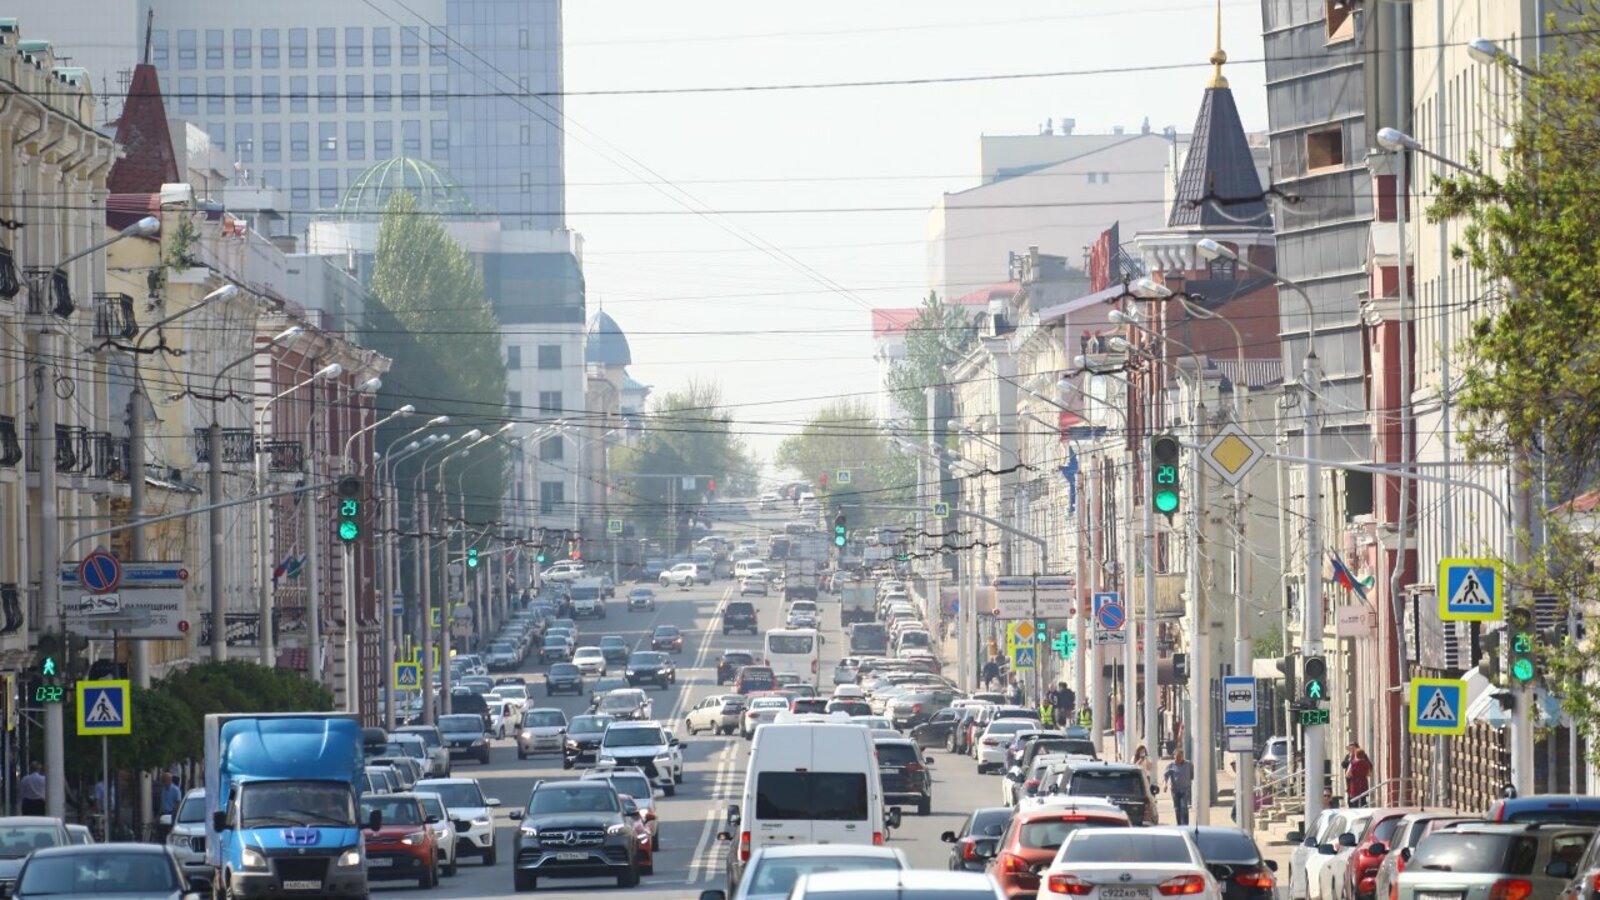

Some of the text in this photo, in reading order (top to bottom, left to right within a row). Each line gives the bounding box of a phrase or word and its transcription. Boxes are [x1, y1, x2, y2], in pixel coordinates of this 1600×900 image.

[1157, 465, 1175, 484] 29
[341, 499, 356, 516] 29
[35, 686, 64, 701] 0:32
